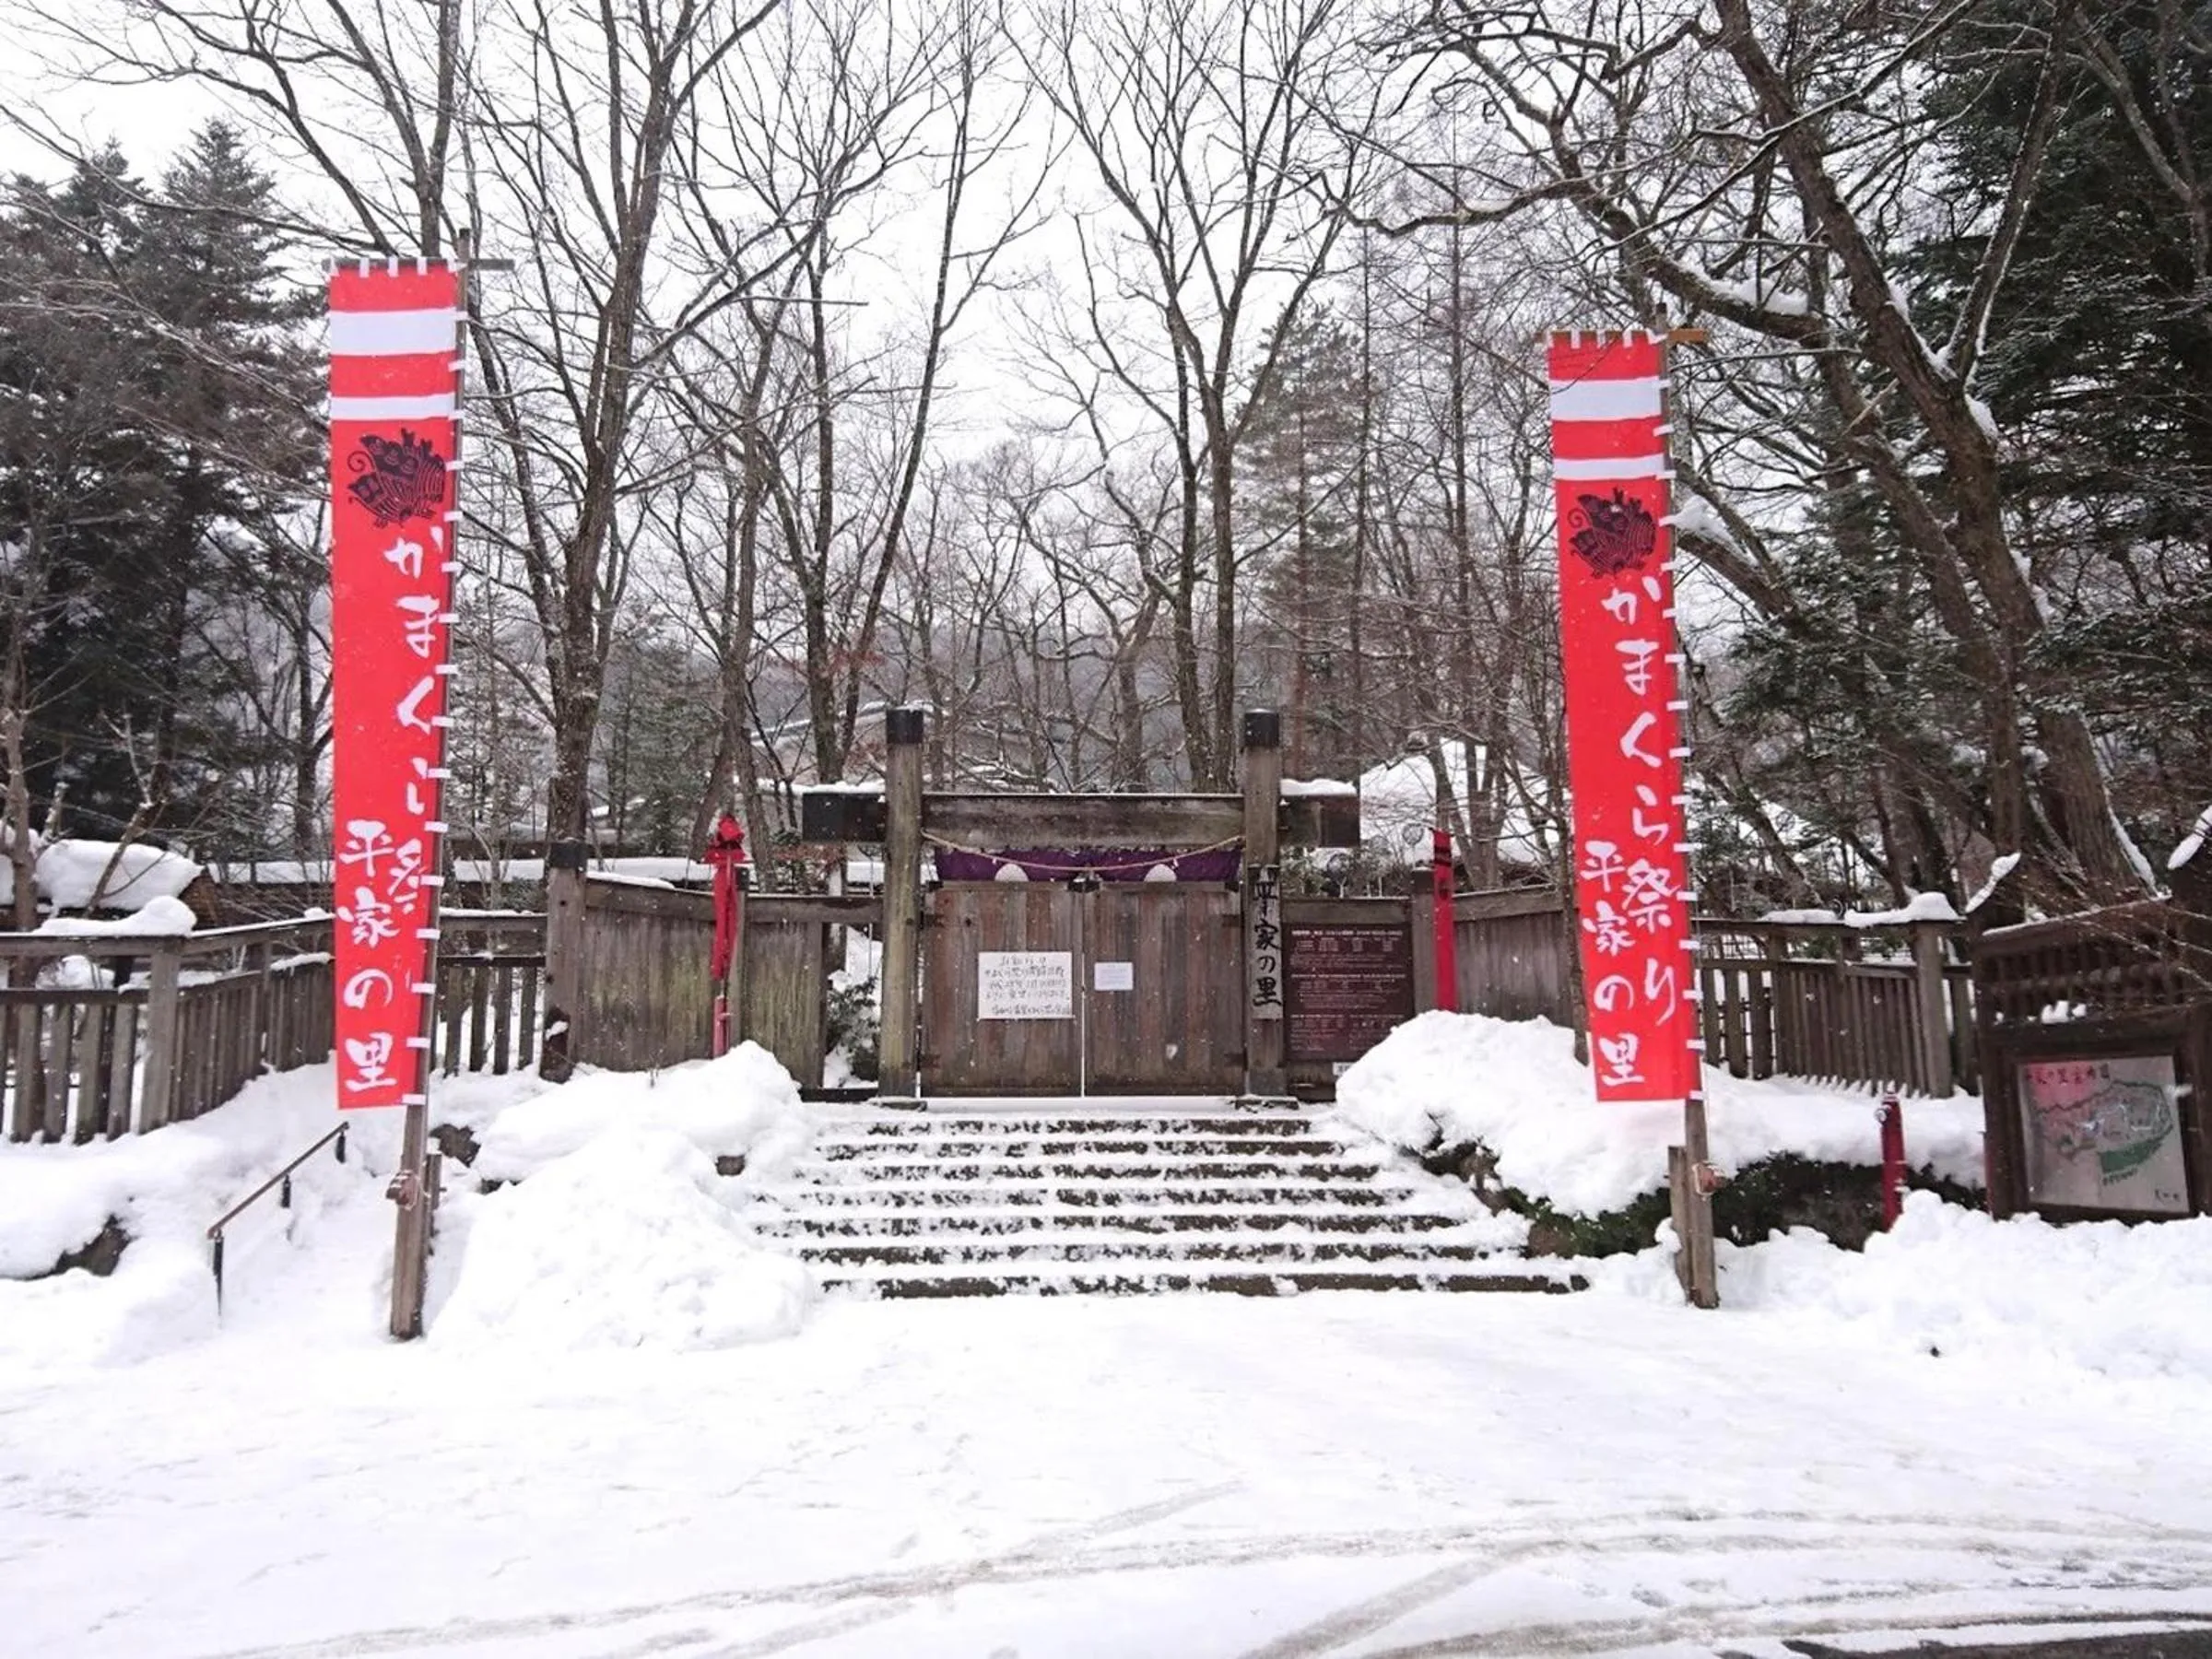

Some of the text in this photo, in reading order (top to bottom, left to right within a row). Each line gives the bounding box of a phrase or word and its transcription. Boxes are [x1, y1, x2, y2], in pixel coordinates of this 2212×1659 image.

[383, 525, 443, 989] かまくら祭
[1601, 576, 1680, 1026] かまくら祭り
[338, 819, 400, 1092] 平家の里
[1253, 881, 1283, 1006] 平家の里
[1580, 840, 1645, 1087] 平家の里
